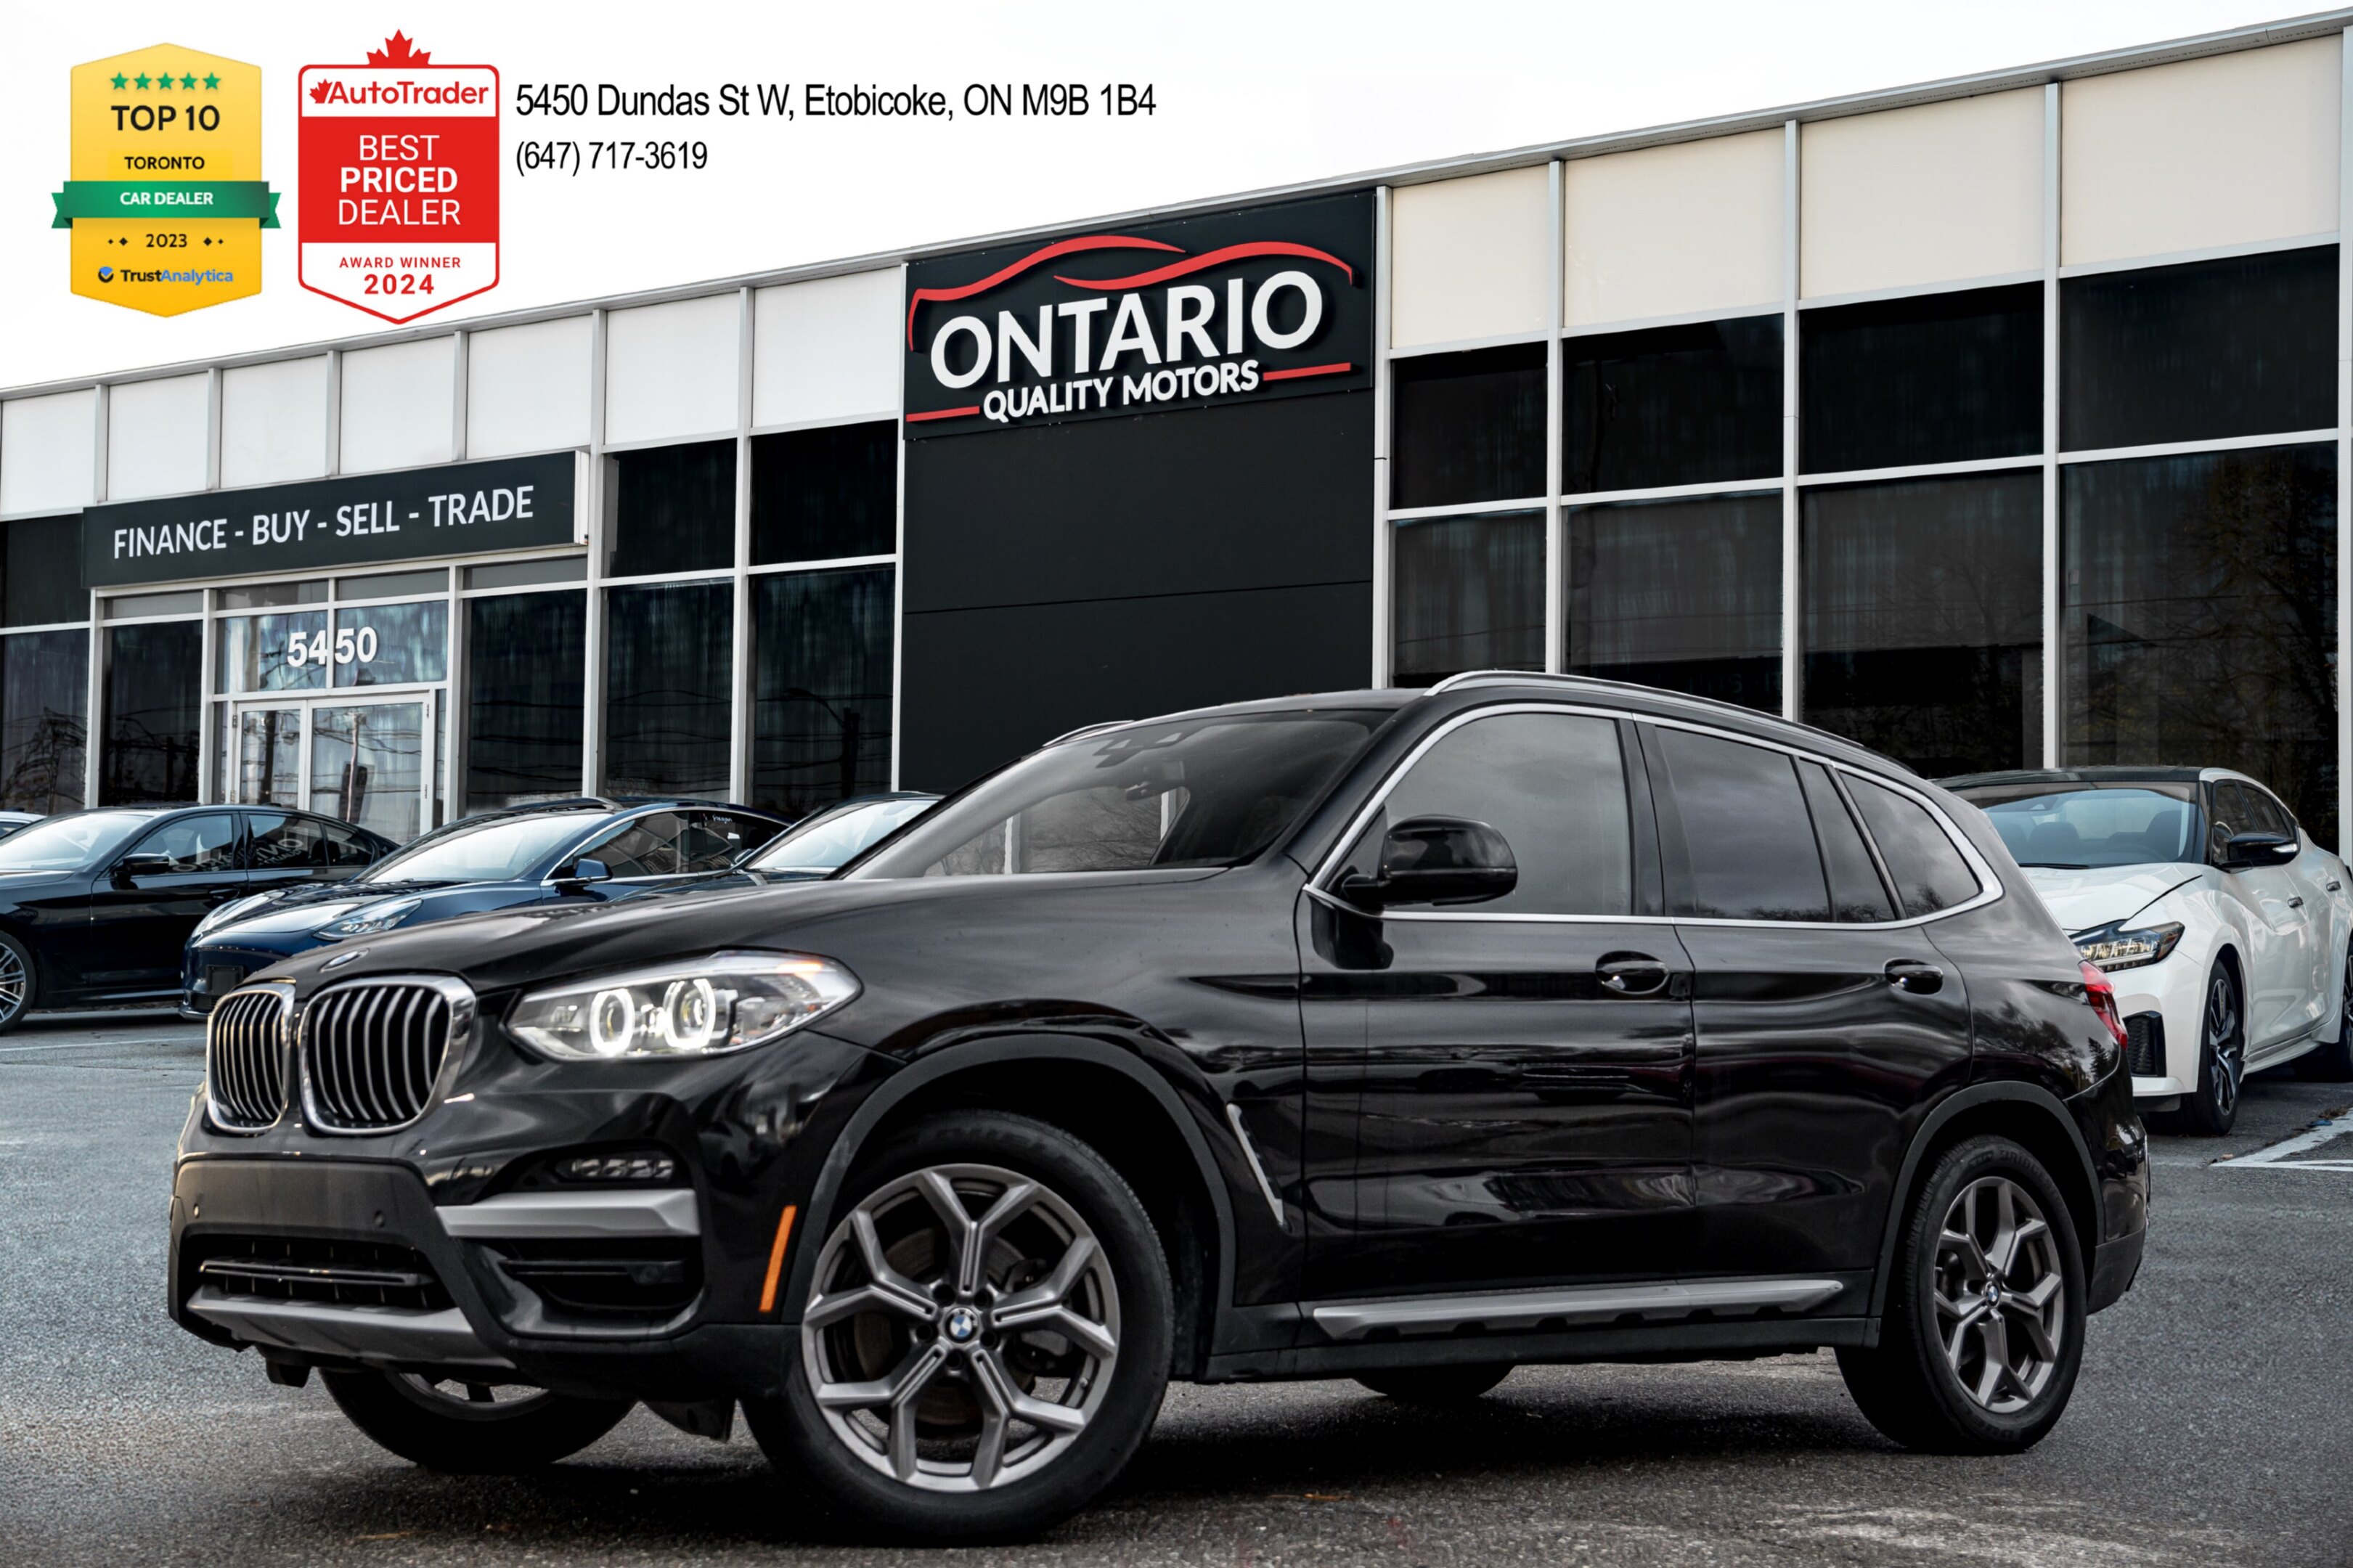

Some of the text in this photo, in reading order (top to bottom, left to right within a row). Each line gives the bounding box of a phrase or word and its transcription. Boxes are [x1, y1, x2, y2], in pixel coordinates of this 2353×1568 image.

[931, 271, 1322, 389] ONTARIO
[983, 359, 1260, 422] QUALITY MOTORS
[115, 518, 227, 558] FINANCE
[253, 510, 310, 544] BUY
[335, 501, 400, 536] SELL
[428, 485, 534, 527] TRADE
[287, 626, 378, 667] 5450
